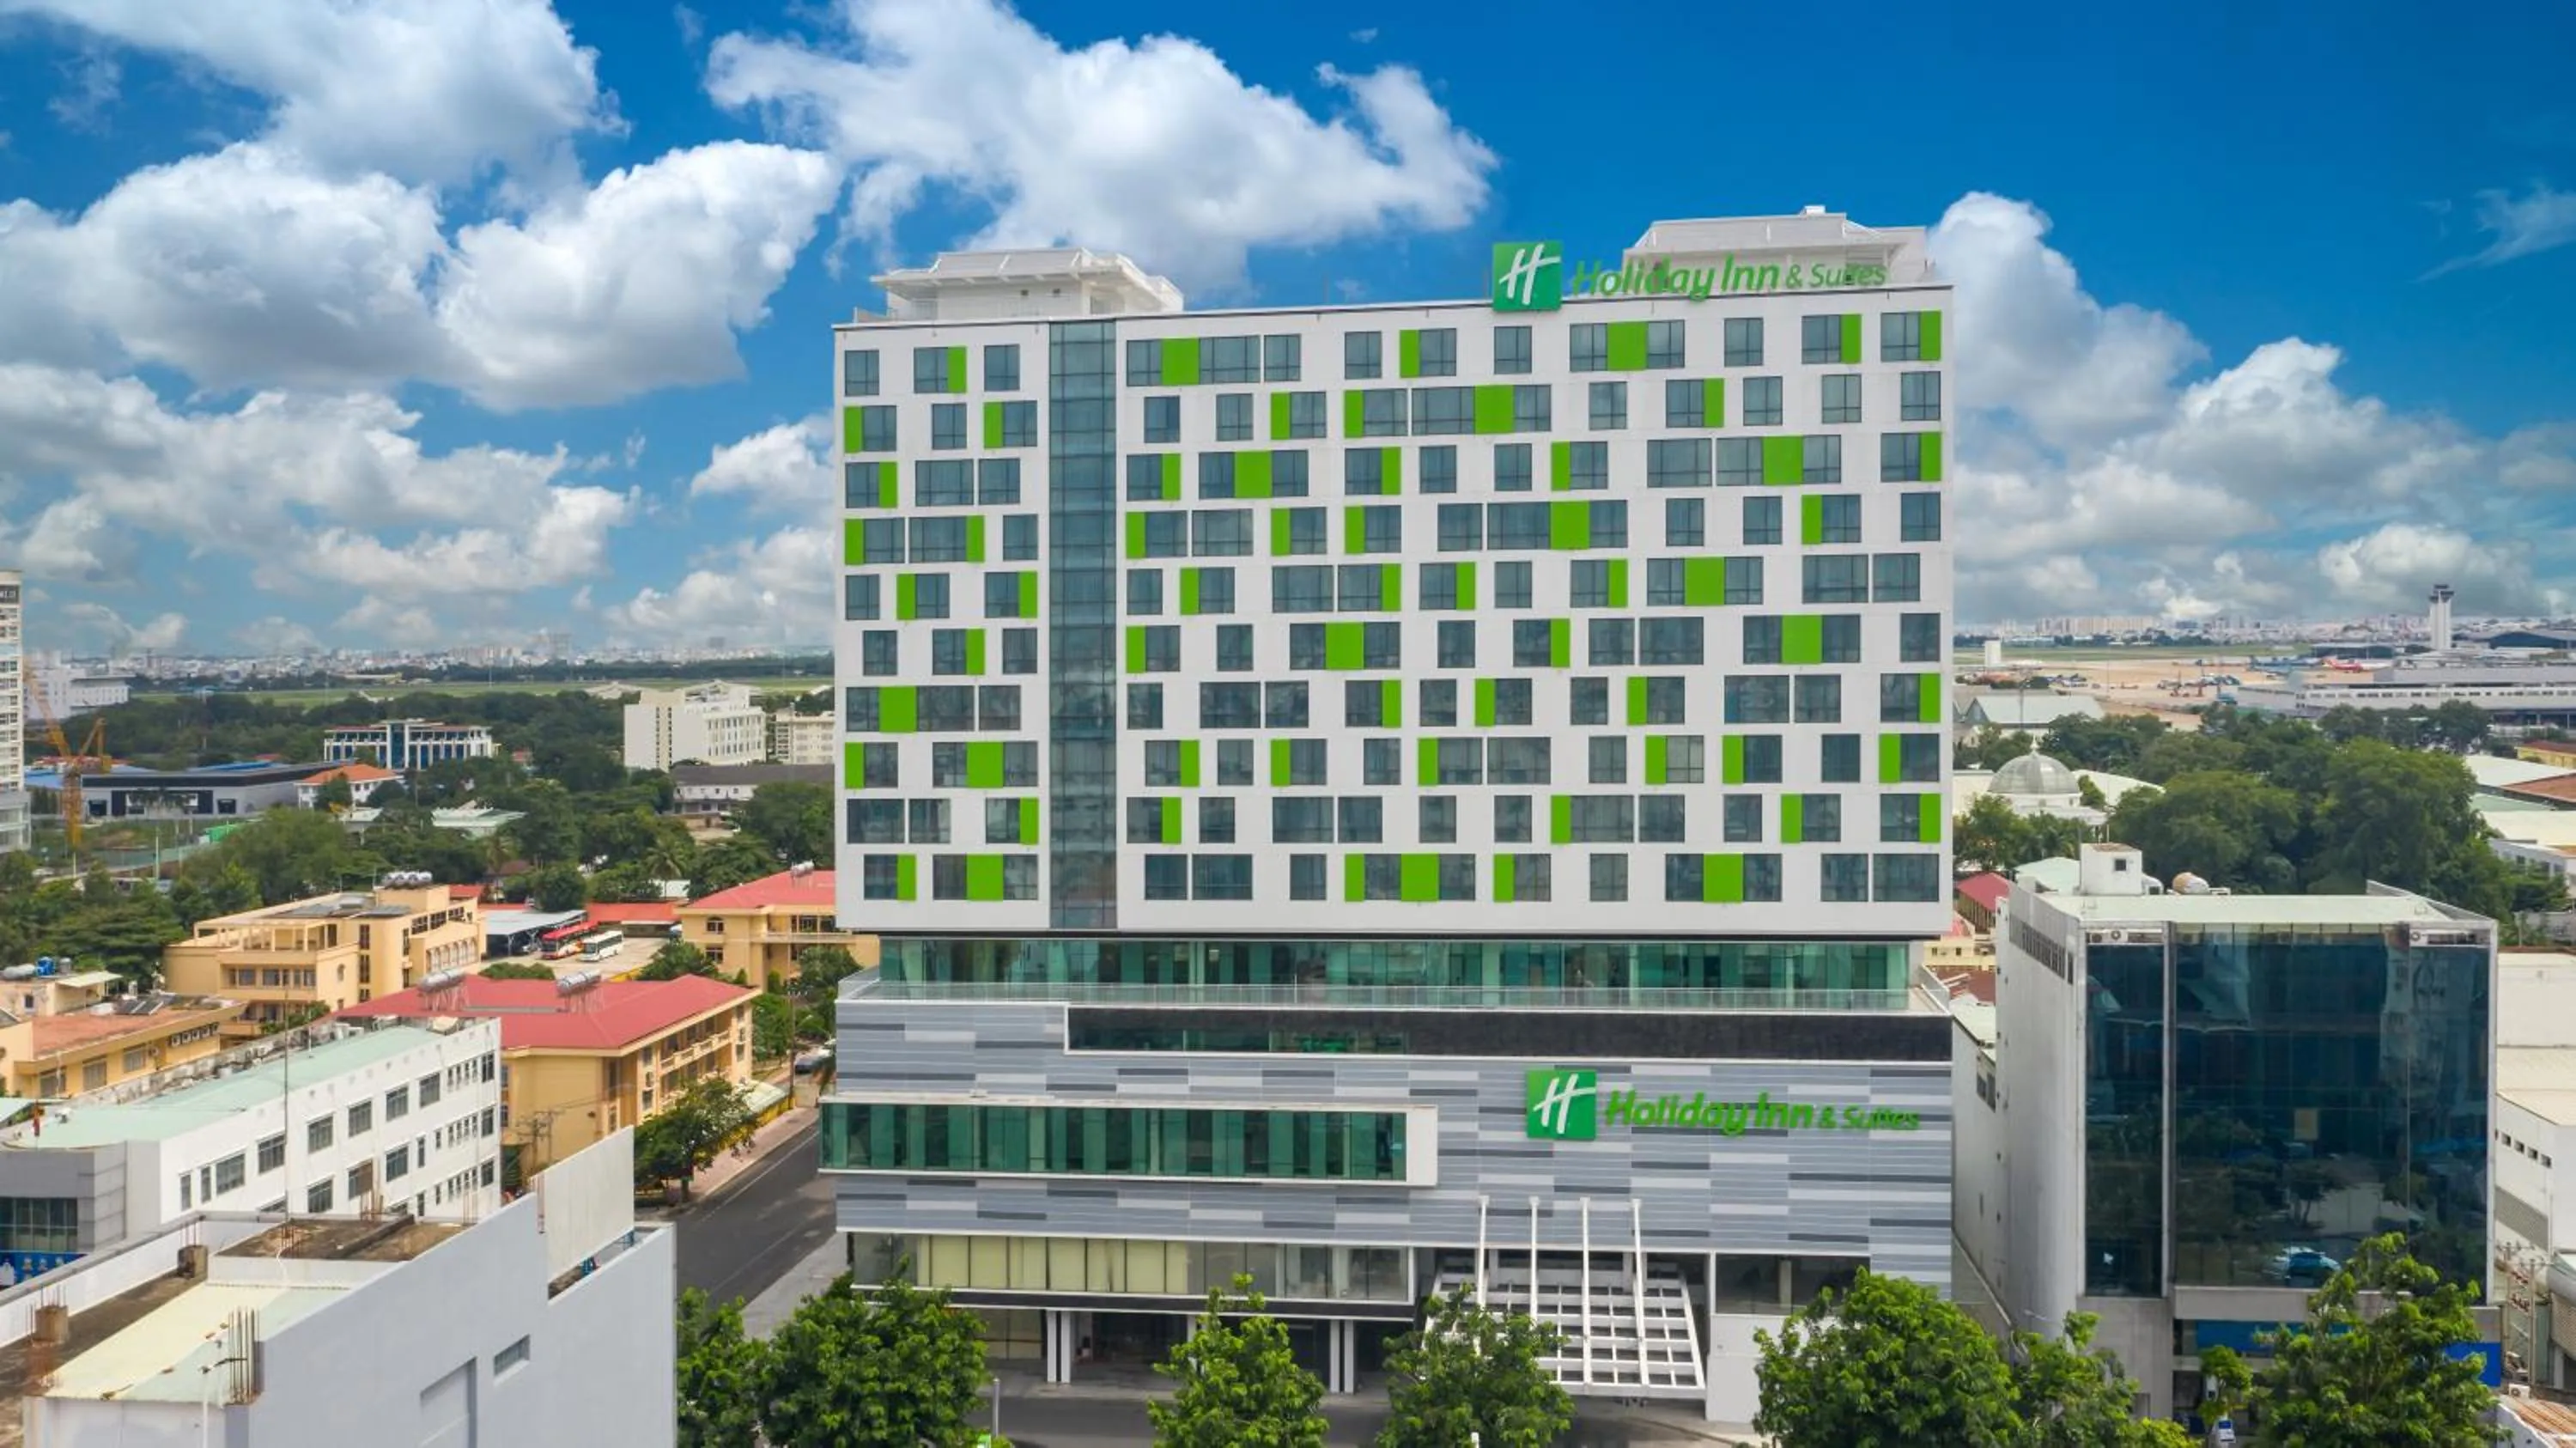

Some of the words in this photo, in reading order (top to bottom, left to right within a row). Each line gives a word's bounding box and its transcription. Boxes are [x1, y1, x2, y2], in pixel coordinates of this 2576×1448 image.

[1572, 252, 1716, 302] Holiday
[1720, 252, 1781, 293] Inn
[1784, 263, 1803, 289] &
[1605, 1090, 1747, 1136] Holiday
[1753, 1092, 1814, 1129] Inn
[1818, 1104, 1838, 1129] &
